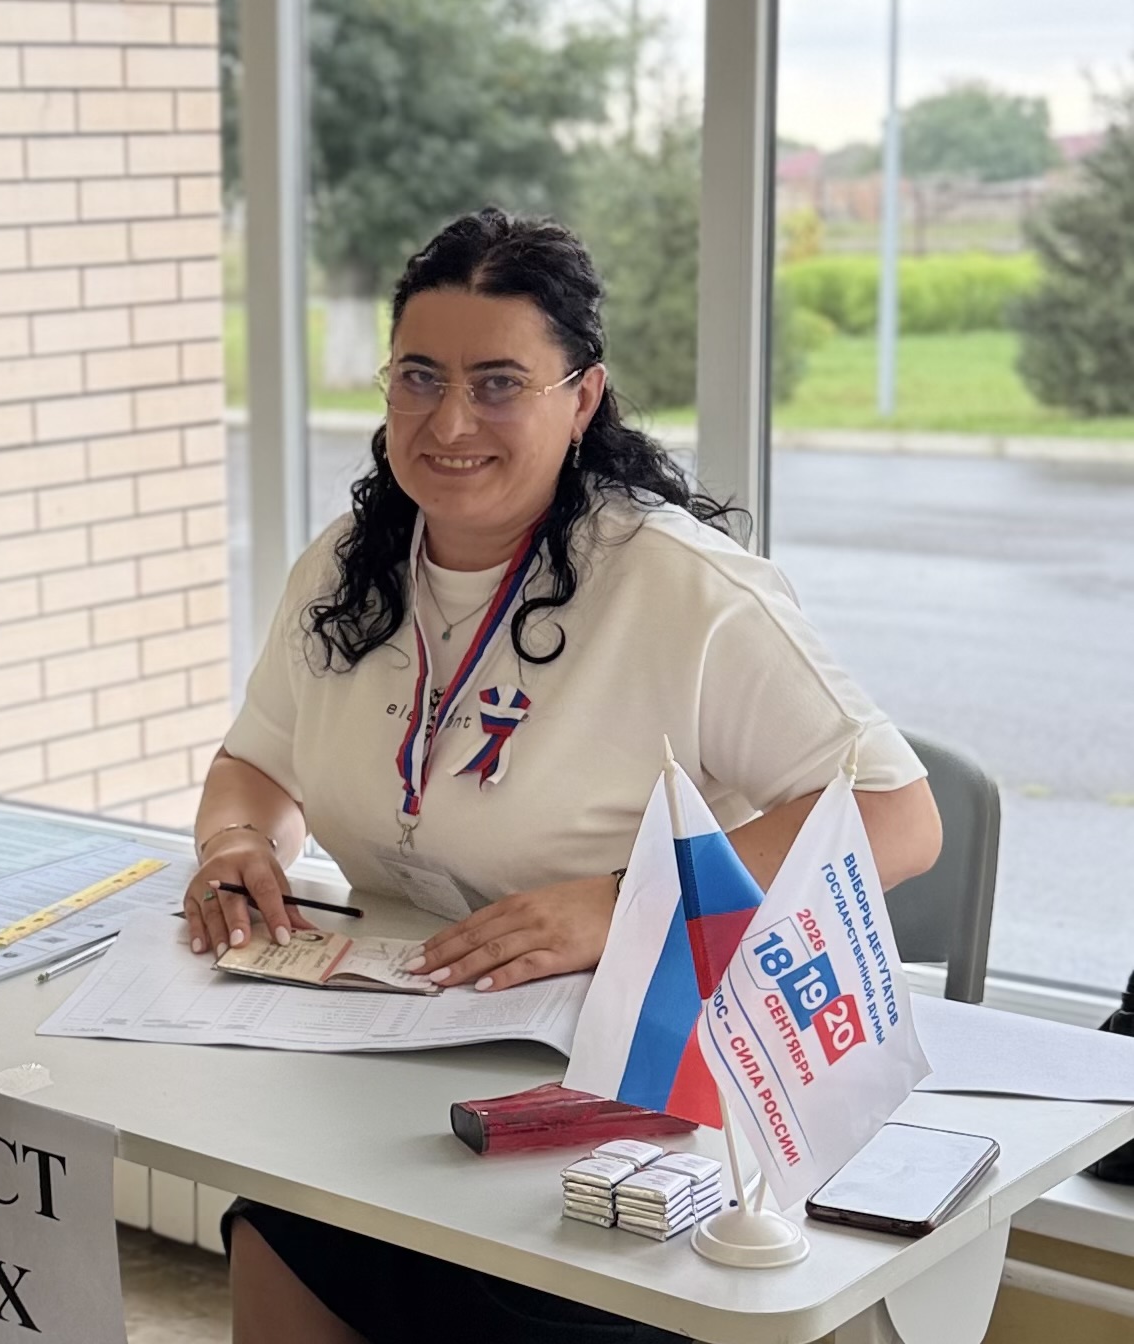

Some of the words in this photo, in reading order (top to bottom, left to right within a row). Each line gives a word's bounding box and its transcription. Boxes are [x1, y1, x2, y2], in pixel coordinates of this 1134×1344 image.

[753, 931, 794, 977] 18
[793, 965, 828, 1011] 19
[823, 1000, 855, 1051] 20
[796, 908, 826, 952] 2026
[821, 863, 875, 1003] ГОСУДАРСТВЕННОЙ
[867, 1002, 886, 1045] ДУМЫ
[843, 852, 875, 931] ВЫБОРЫ
[866, 931, 899, 1027] ДЕПУТАТОВ
[730, 1036, 765, 1089] СИЛА
[757, 1088, 801, 1167] РОССИИ!
[764, 994, 814, 1086] СЕНТЯБРЯ
